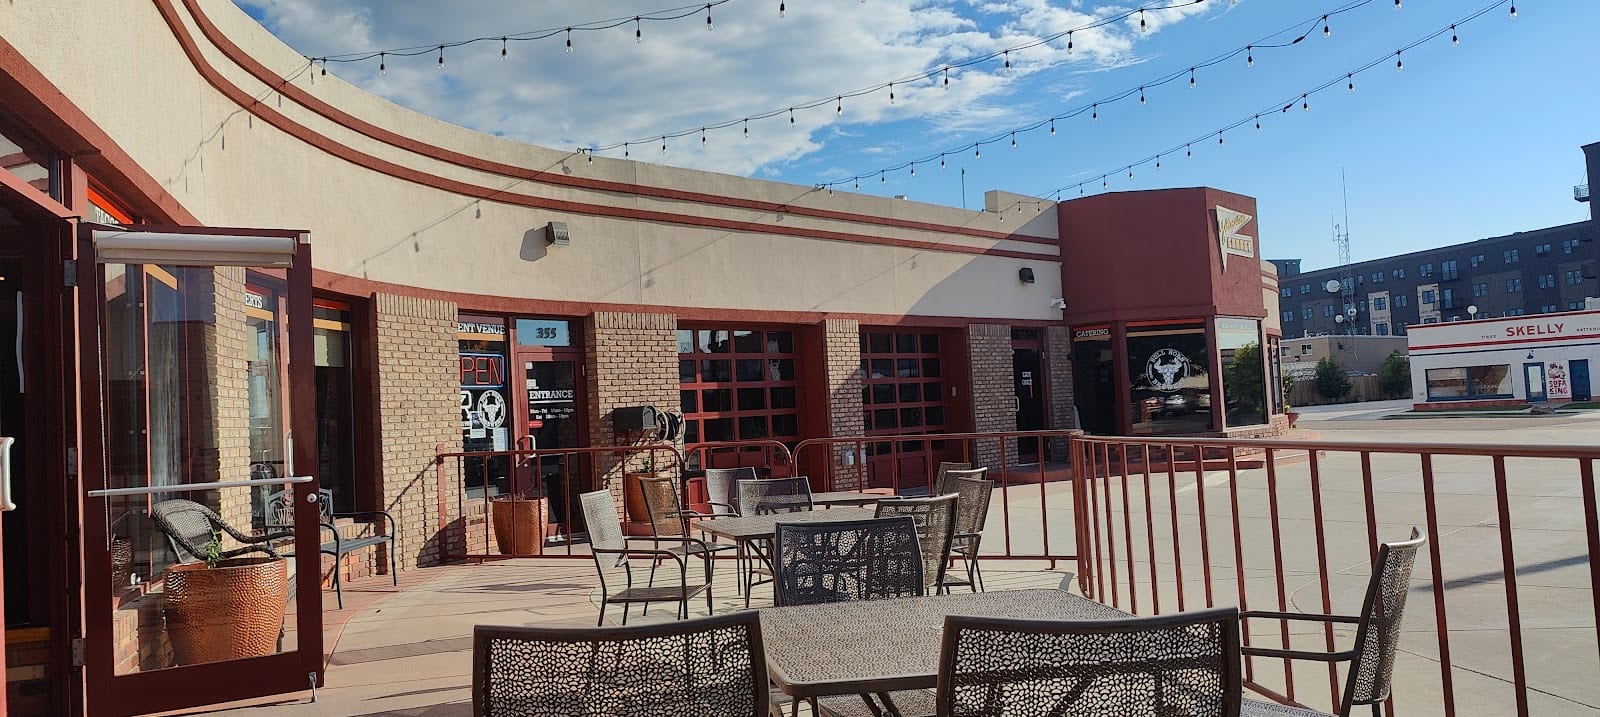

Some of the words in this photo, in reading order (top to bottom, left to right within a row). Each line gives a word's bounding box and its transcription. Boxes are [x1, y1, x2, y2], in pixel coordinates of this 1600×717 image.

[476, 324, 505, 334] VENUE
[536, 328, 557, 338] 355
[1075, 329, 1109, 338] CATERING
[1505, 323, 1564, 337] SKELLY
[461, 357, 502, 385] PEN
[1549, 380, 1567, 388] SOFA
[528, 390, 574, 400] ENTRANCE
[1549, 387, 1569, 395] KING
